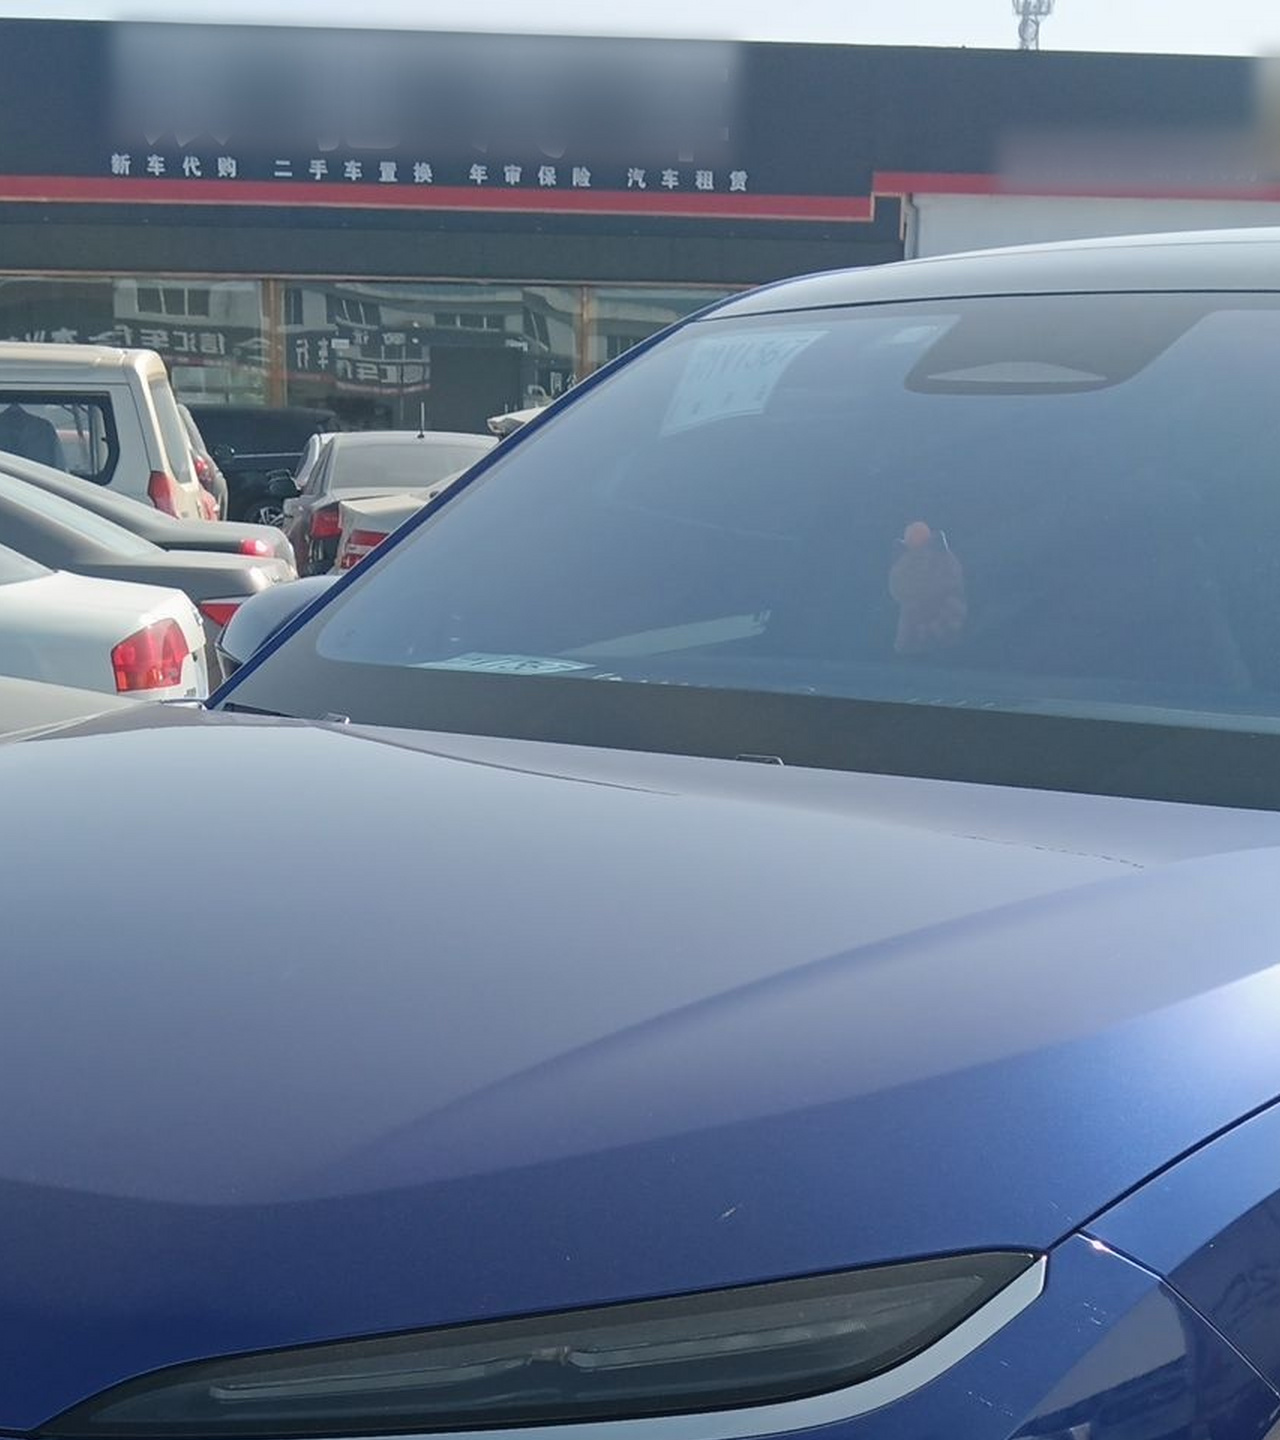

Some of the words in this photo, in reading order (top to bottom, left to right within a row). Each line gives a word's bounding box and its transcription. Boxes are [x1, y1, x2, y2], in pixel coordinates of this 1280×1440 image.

[111, 153, 237, 178] 新车代购
[274, 159, 433, 183] 二手车置换
[469, 163, 591, 187] 年审保险
[627, 167, 748, 192] 汽车租赁
